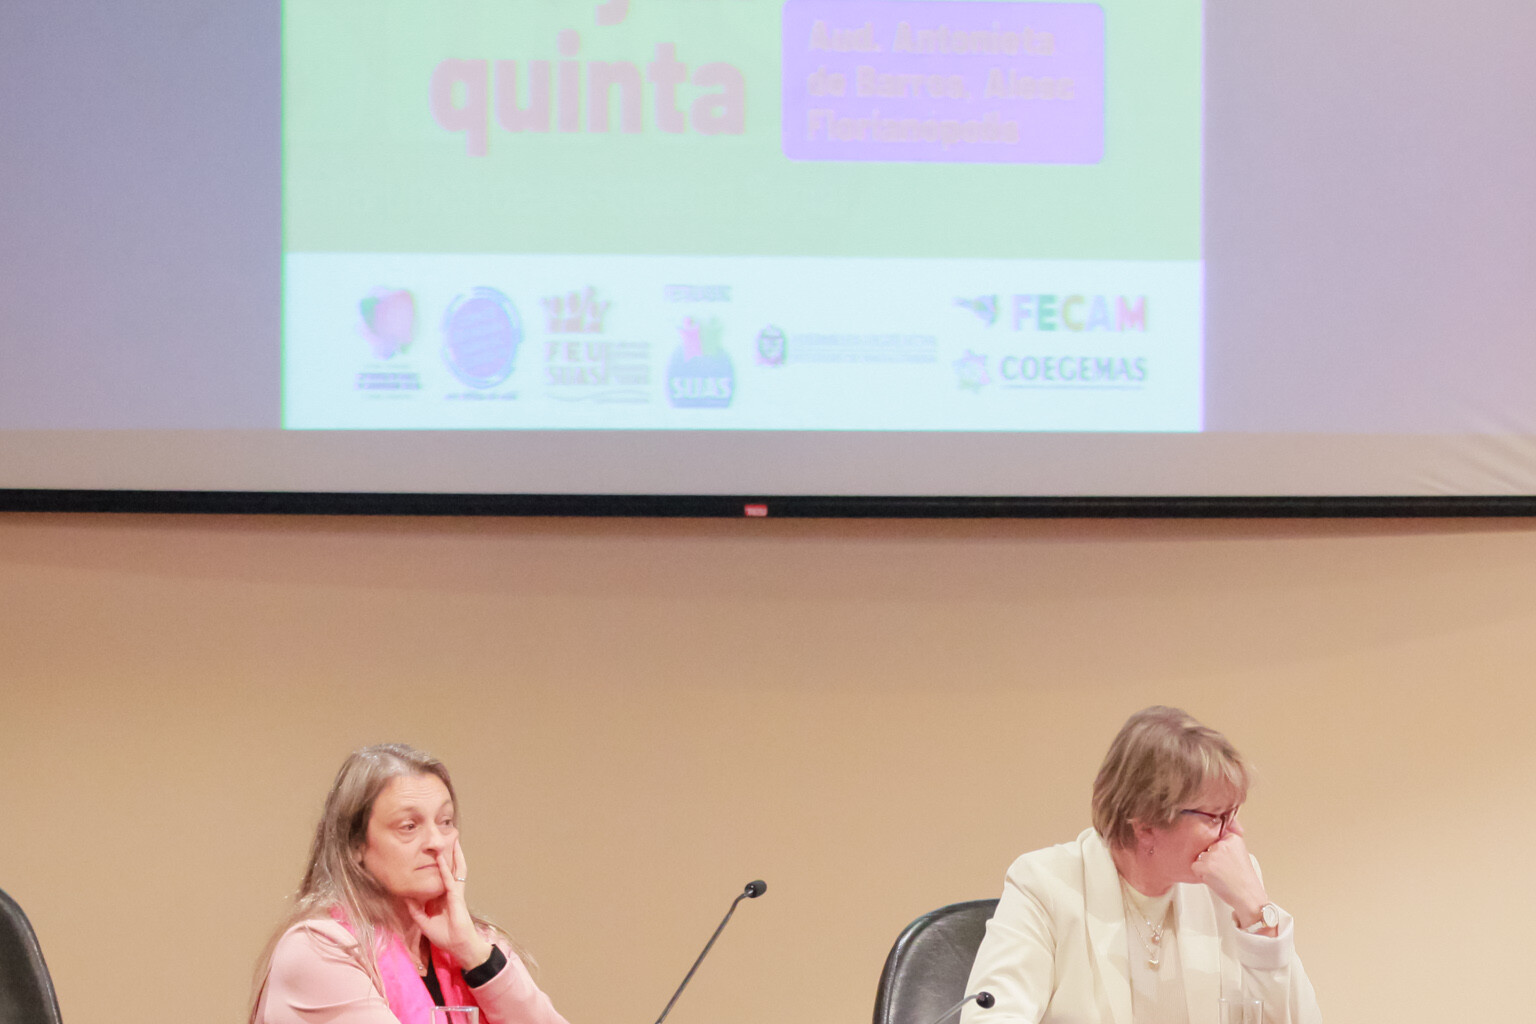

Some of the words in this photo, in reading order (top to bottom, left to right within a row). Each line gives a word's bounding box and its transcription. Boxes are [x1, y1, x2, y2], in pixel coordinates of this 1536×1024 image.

[428, 28, 746, 157] quinta
[1010, 293, 1149, 332] FECAM
[999, 355, 1149, 382] COEGEMAS
